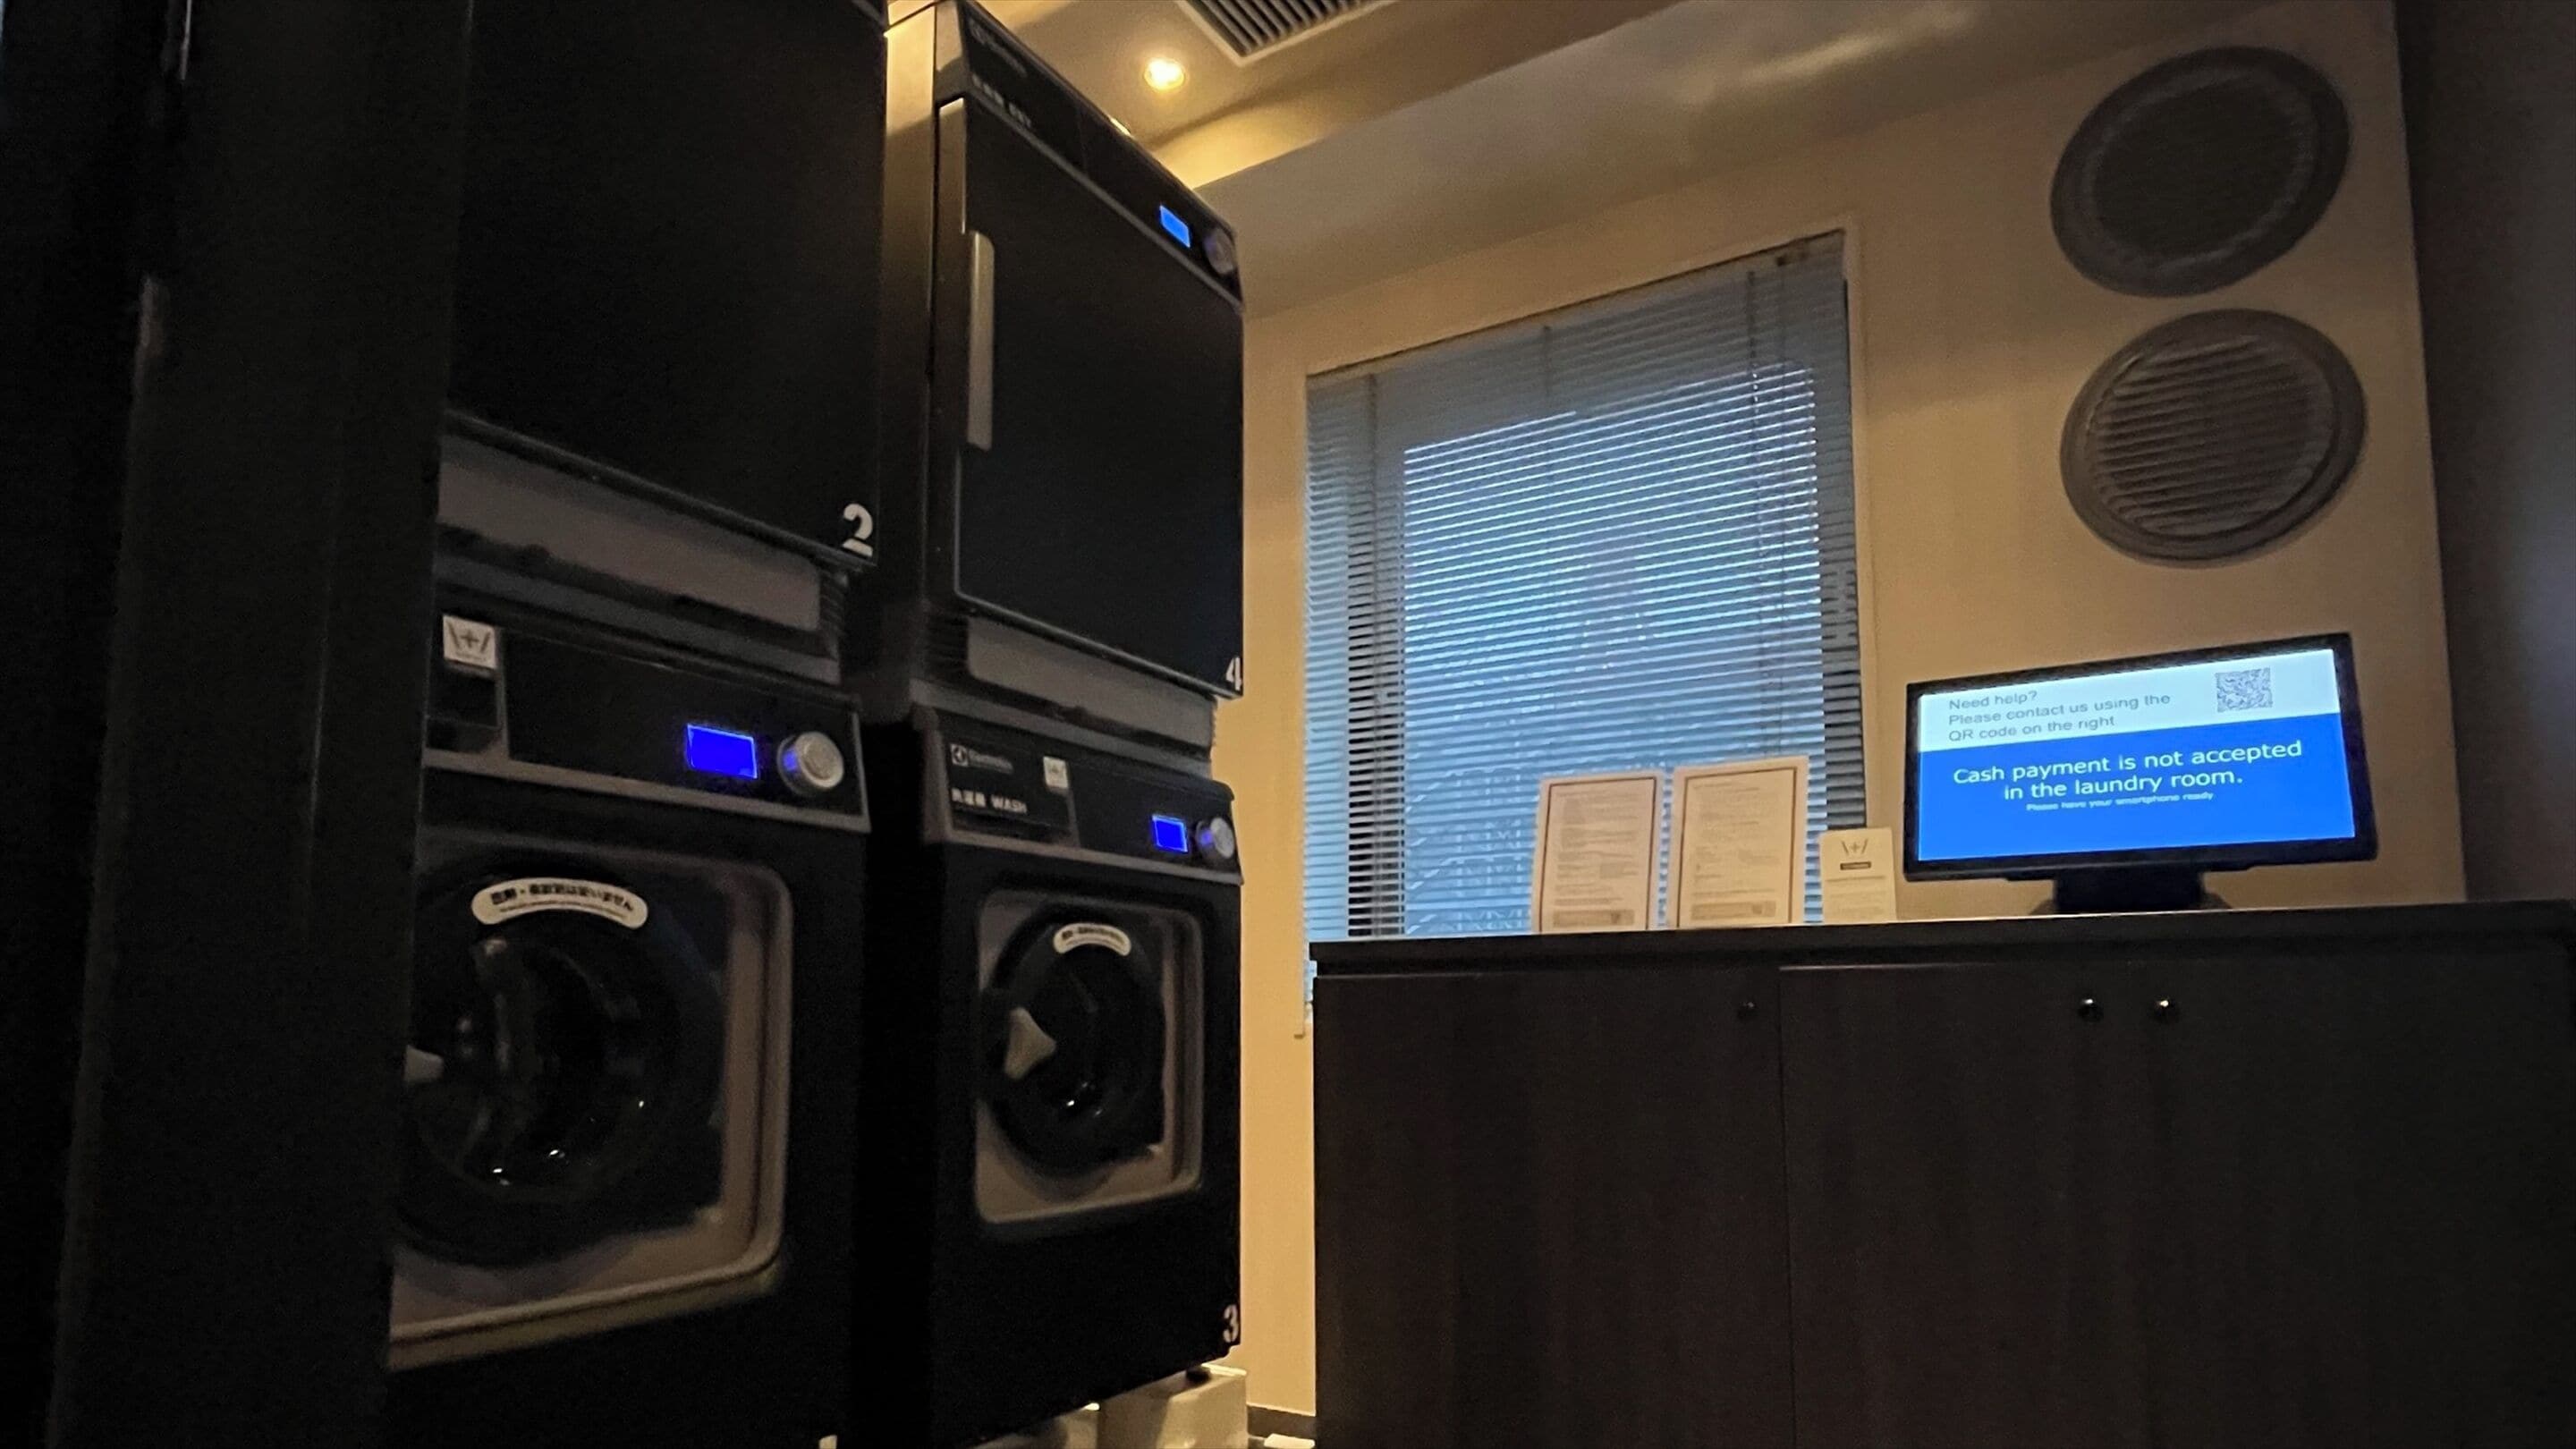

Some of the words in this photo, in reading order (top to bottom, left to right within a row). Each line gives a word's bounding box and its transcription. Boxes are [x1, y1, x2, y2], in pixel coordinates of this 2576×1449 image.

[843, 503, 873, 556] 2
[1226, 656, 1241, 691] 4
[1948, 696, 1990, 710] Need
[1995, 691, 2038, 706] help?
[1948, 709, 2002, 725] Please
[2006, 705, 2064, 720] contact
[2069, 702, 2089, 714] us
[2094, 697, 2140, 712] using
[2145, 693, 2171, 706] the
[1948, 729, 1974, 742] QR
[1979, 724, 2017, 740] code
[2021, 723, 2042, 735] on
[2047, 721, 2072, 733] the
[2078, 715, 2115, 732] right
[1953, 766, 2005, 784] Cash
[2012, 757, 2112, 783] payment
[2118, 754, 2137, 771] is
[2144, 750, 2184, 768] not
[2191, 739, 2302, 764] accepted
[2004, 784, 2023, 800] in
[2030, 782, 2068, 799] the
[2074, 775, 2163, 795] laundry
[2171, 770, 2243, 788] room.
[990, 794, 1028, 814] WASH
[1223, 1304, 1239, 1343] 3
